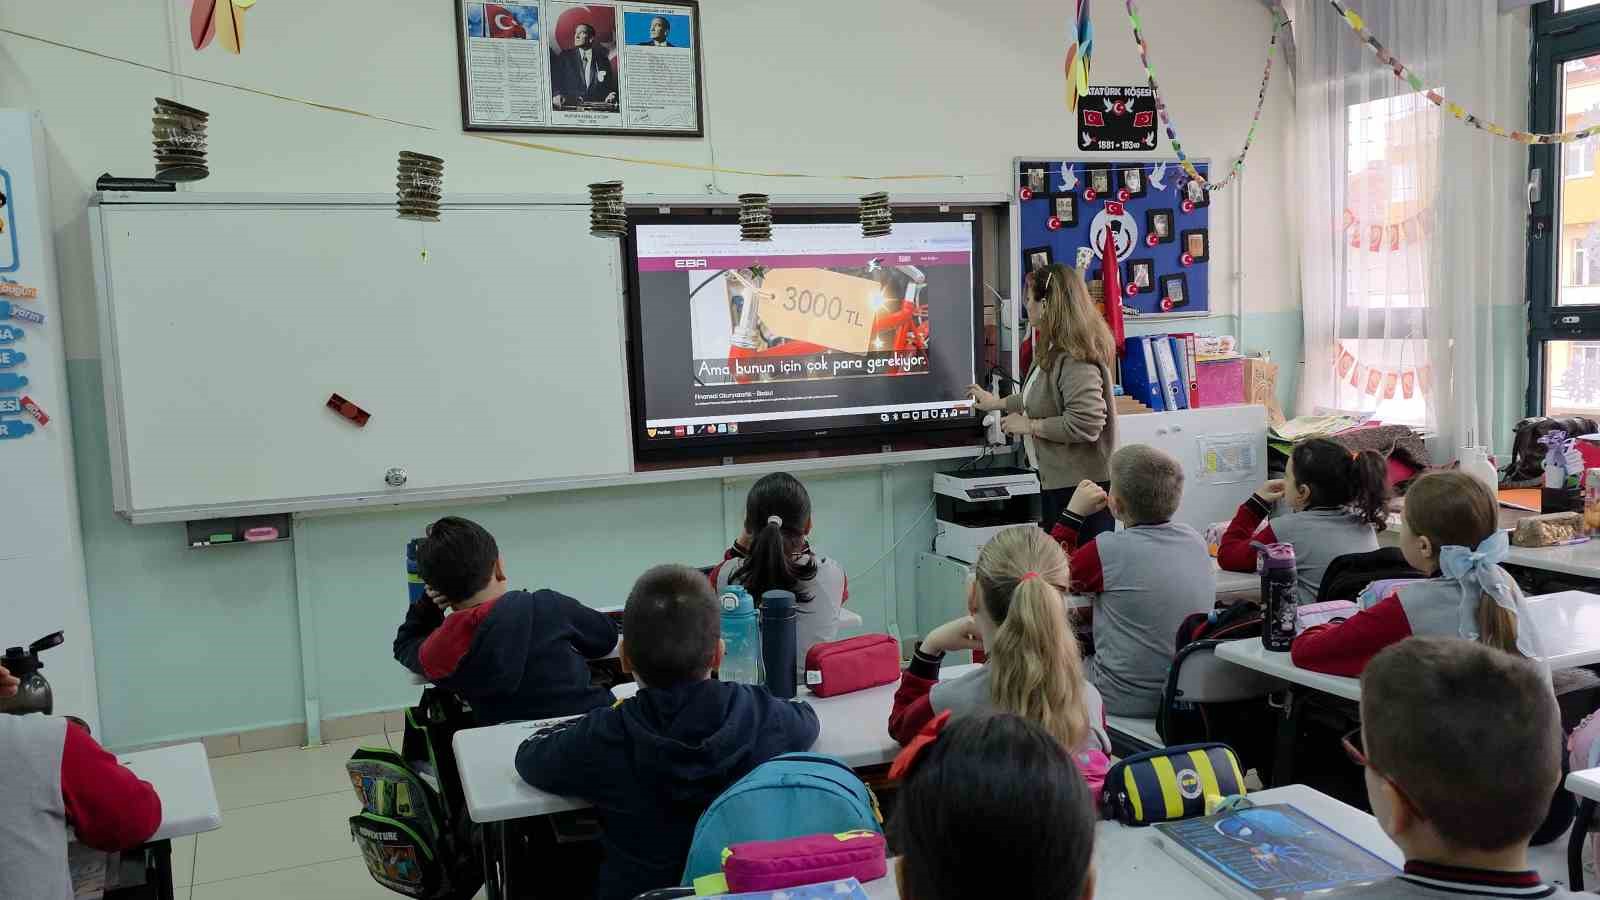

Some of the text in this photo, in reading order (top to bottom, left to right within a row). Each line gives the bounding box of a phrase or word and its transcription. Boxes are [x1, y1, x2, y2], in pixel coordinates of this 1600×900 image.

[675, 259, 707, 268] EBA
[783, 286, 864, 327] 3000 TL
[698, 352, 928, 377] Ama bunun için çok para gerekiyor.
